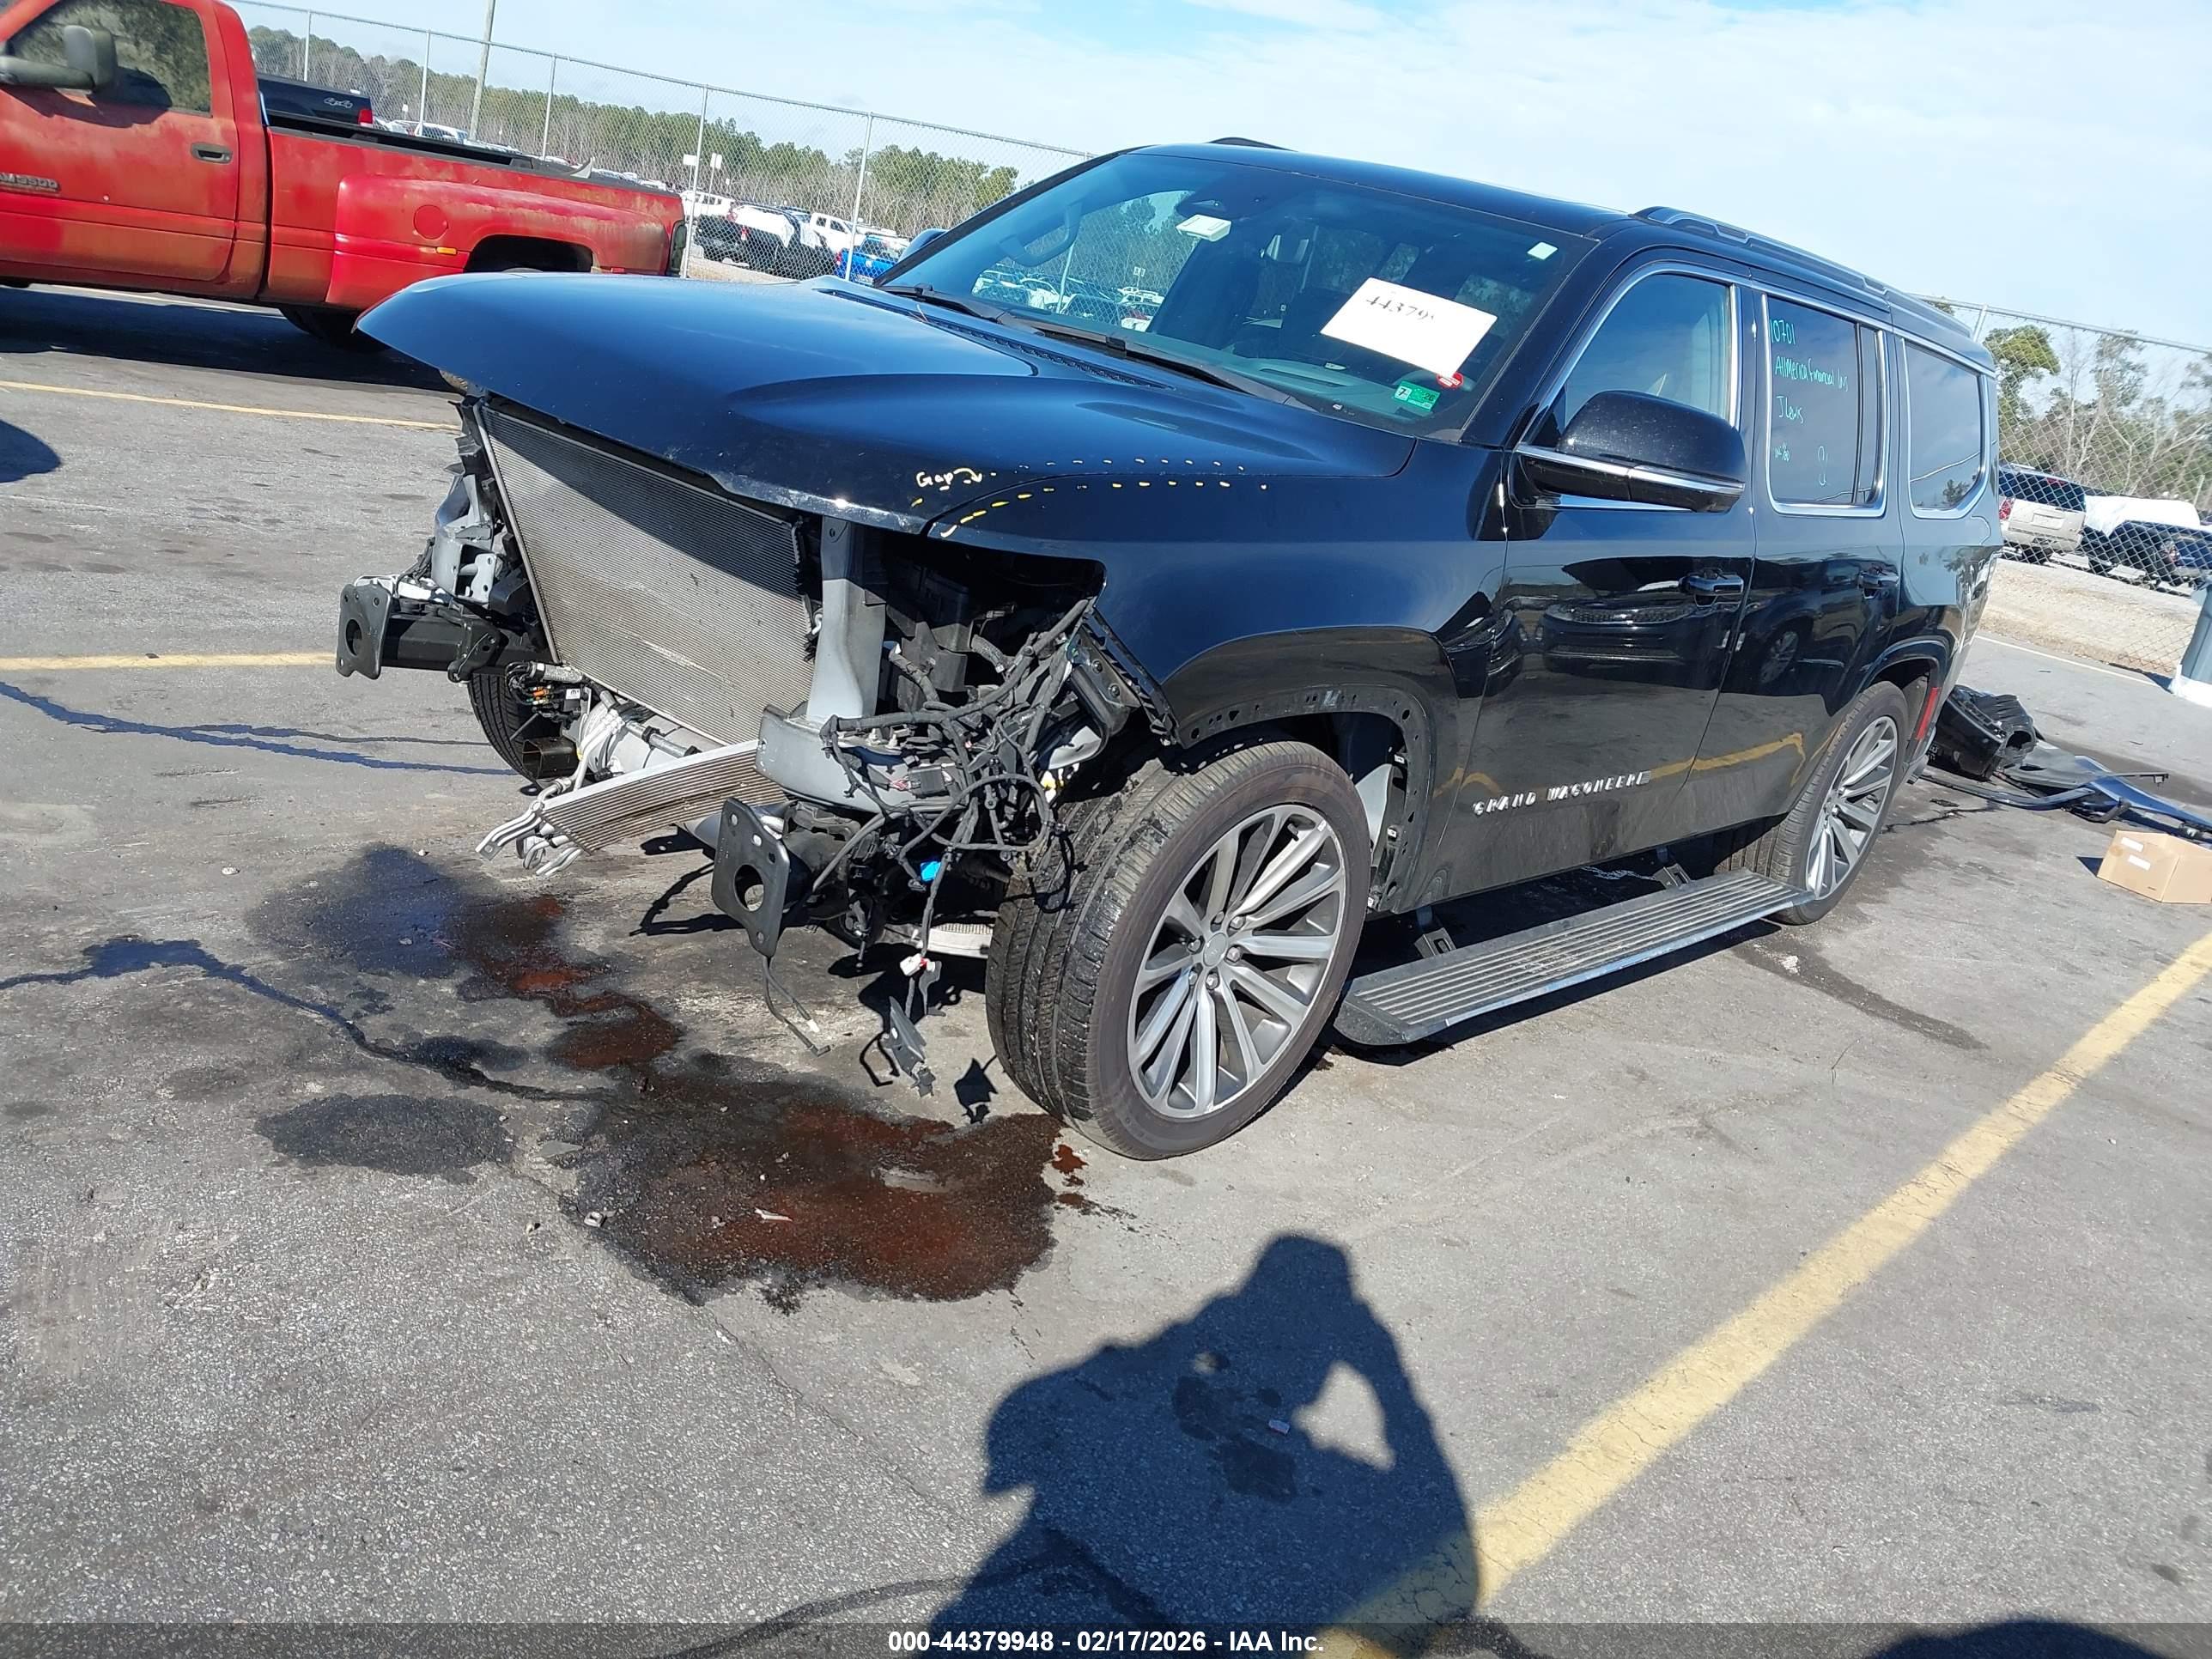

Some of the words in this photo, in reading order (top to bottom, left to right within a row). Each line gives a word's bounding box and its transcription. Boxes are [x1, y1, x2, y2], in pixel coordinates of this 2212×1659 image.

[915, 471, 953, 487] Gap
[1472, 792, 1537, 816] GRAND
[1546, 775, 1637, 802] WAGONEER
